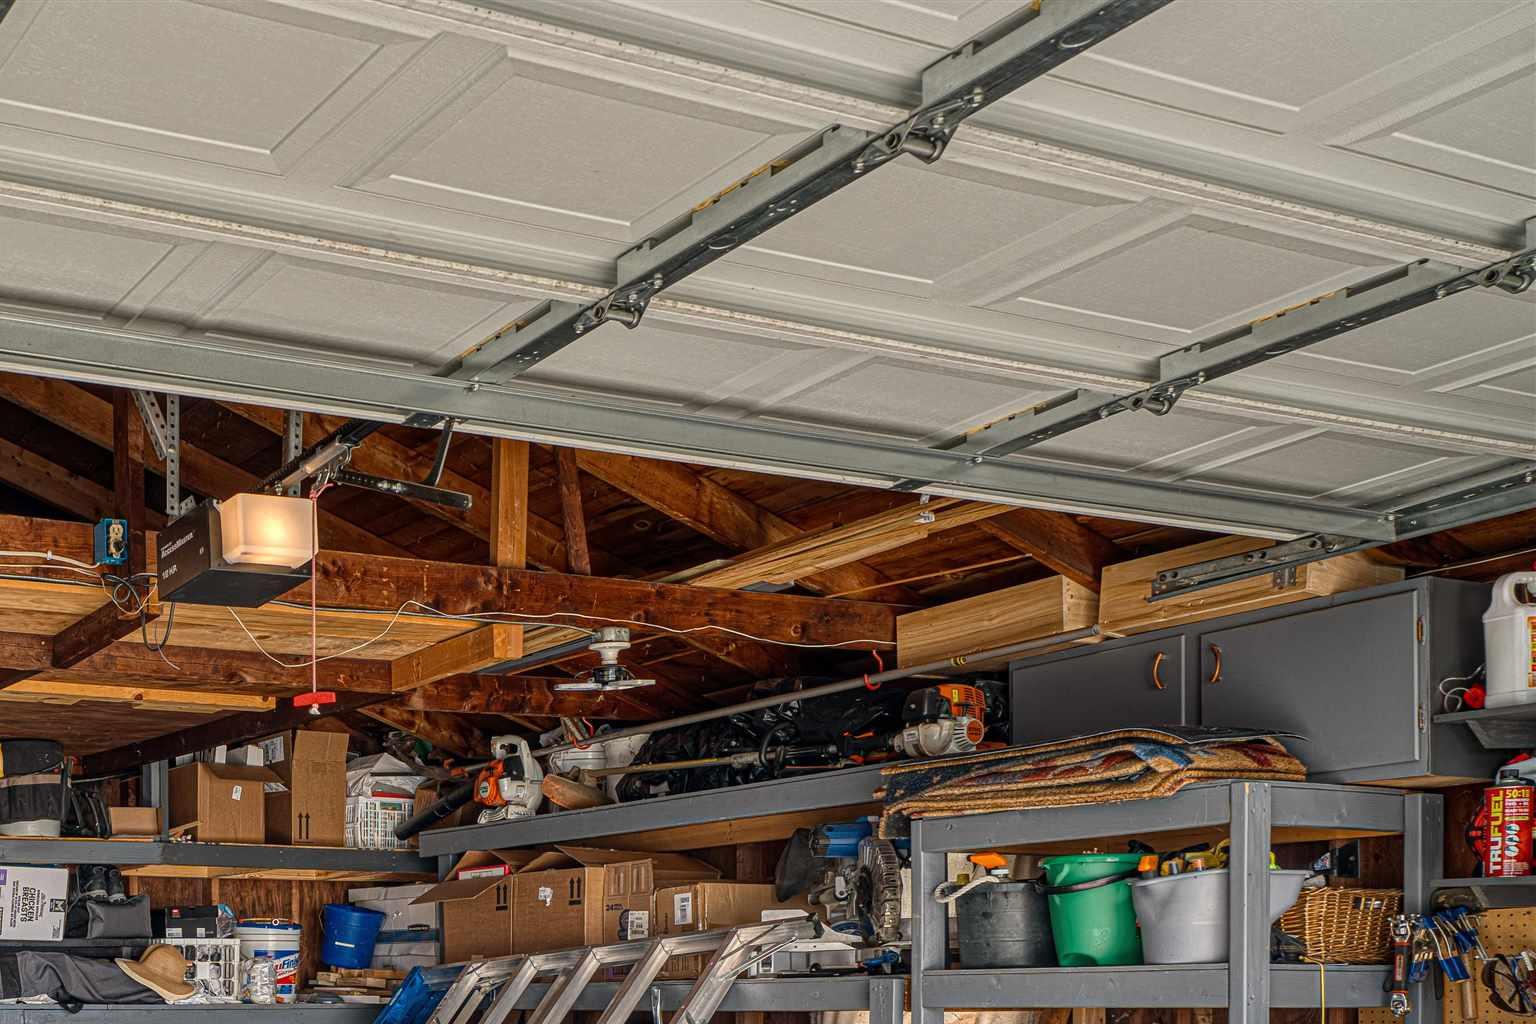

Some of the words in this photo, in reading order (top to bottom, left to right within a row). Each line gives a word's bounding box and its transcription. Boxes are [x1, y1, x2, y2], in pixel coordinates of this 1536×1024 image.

[1489, 790, 1504, 874] TRUFUEL
[20, 887, 29, 923] BREASTS
[27, 888, 37, 922] CHICKEN
